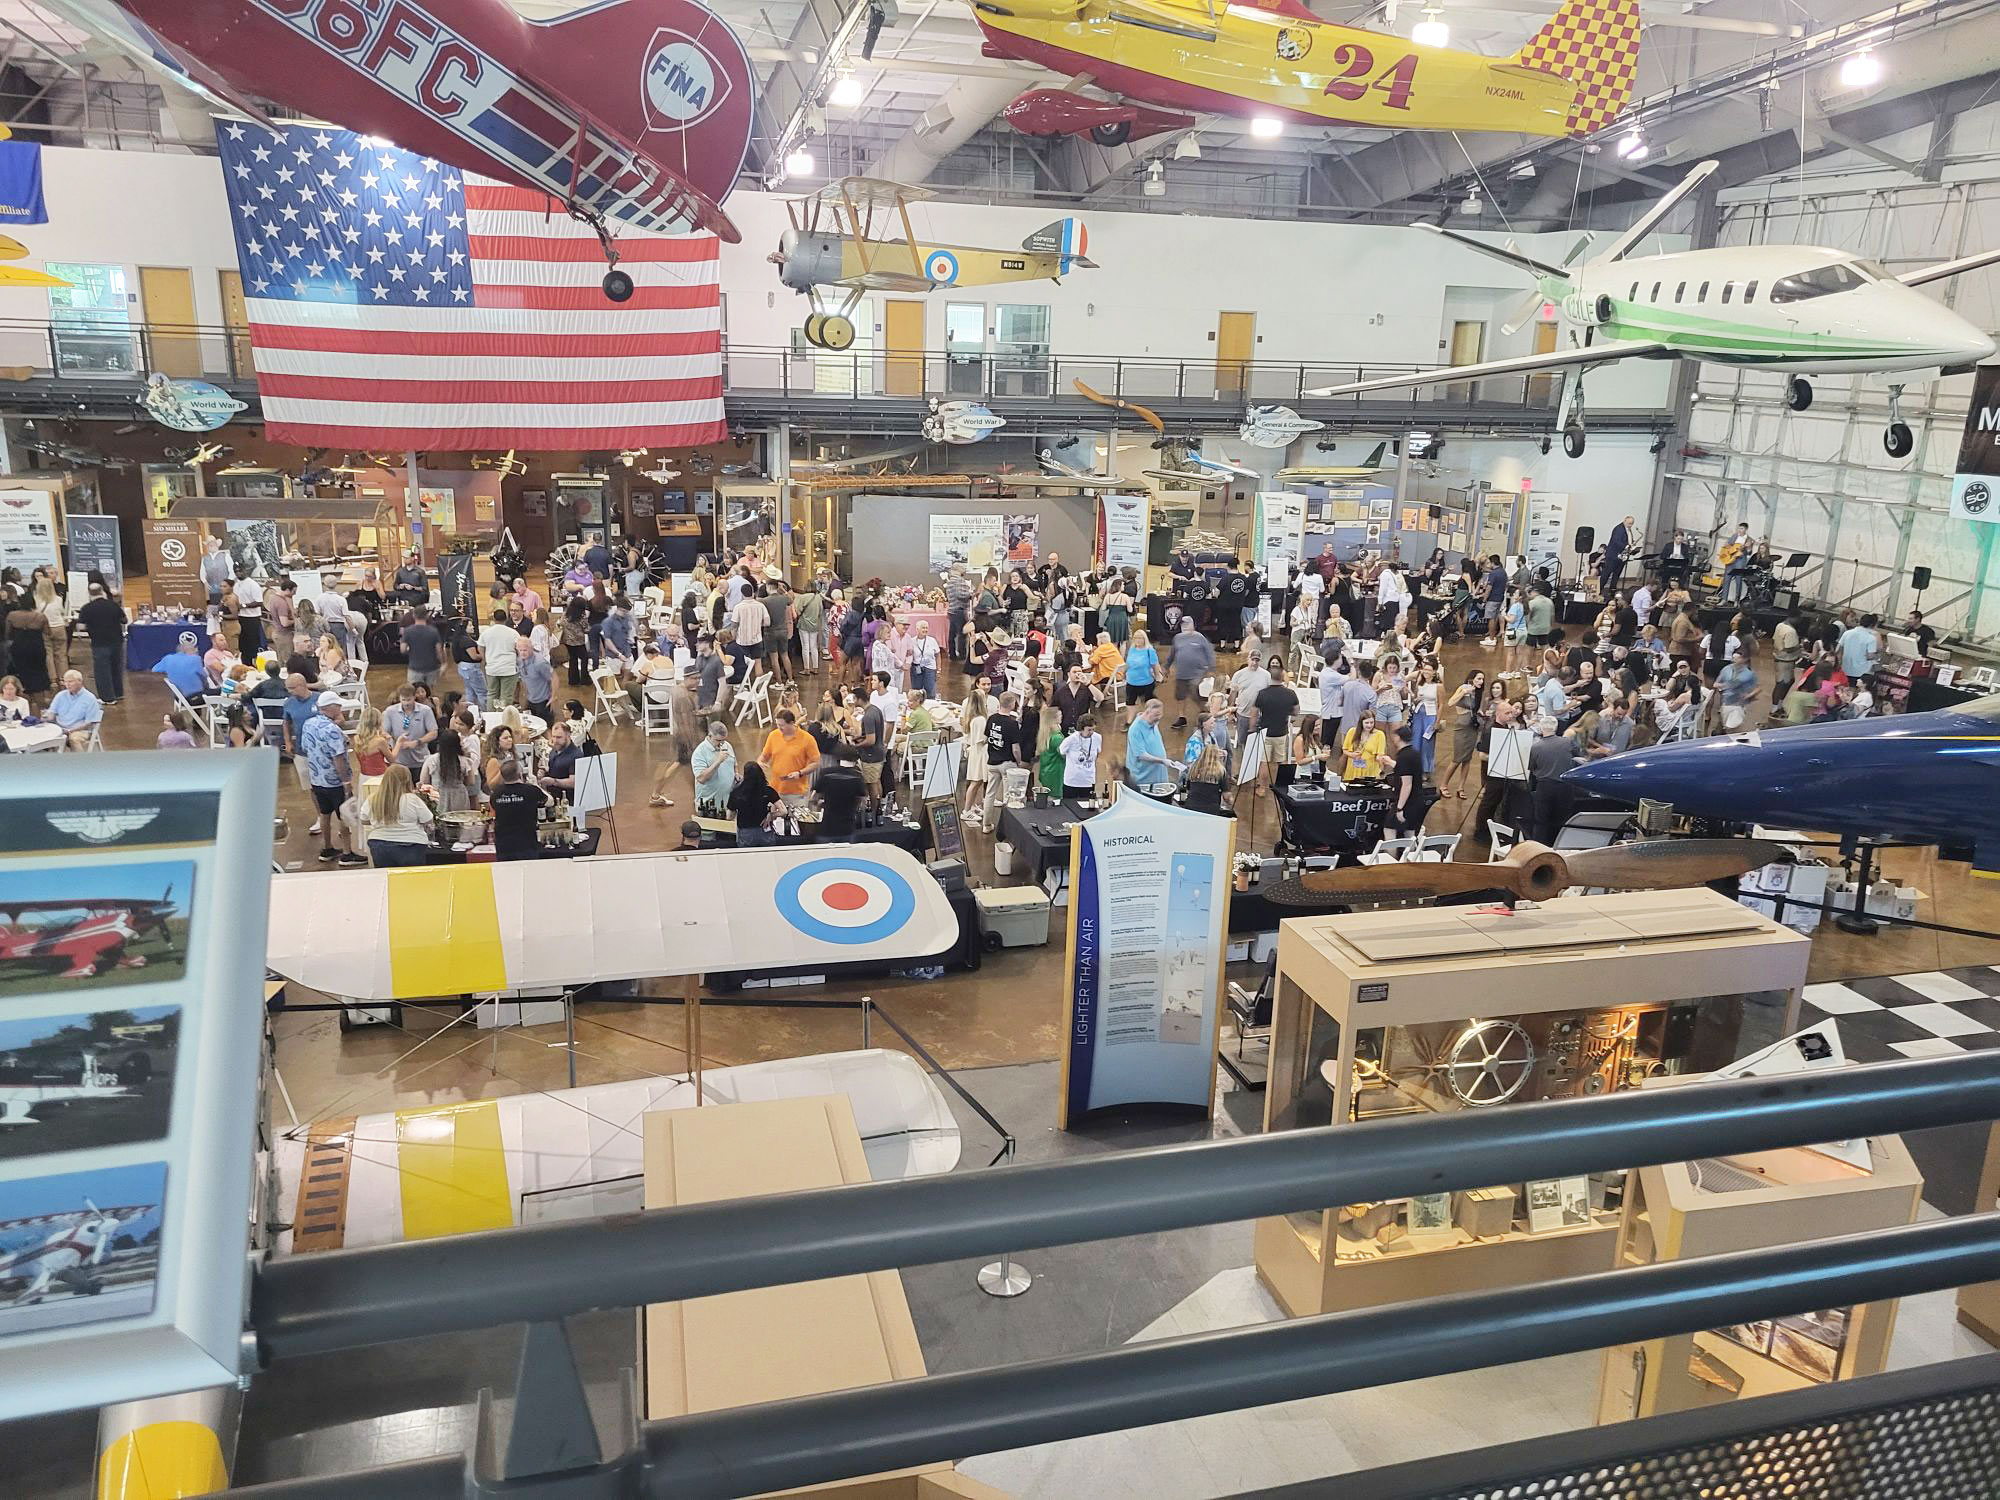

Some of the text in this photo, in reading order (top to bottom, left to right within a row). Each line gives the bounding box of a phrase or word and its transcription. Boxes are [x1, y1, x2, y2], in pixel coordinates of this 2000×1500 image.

[650, 53, 707, 112] FINA
[1323, 44, 1419, 111] 24
[1485, 86, 1526, 101] NX24ML
[190, 401, 217, 409] World
[1966, 492, 1988, 505] 50
[74, 529, 112, 539] LANDON
[992, 722, 1002, 732] Let
[1331, 798, 1394, 813] Beef Jerk
[1103, 835, 1155, 848] HISTORICAL
[1076, 918, 1094, 1045] LIGHTER THAN AIR
